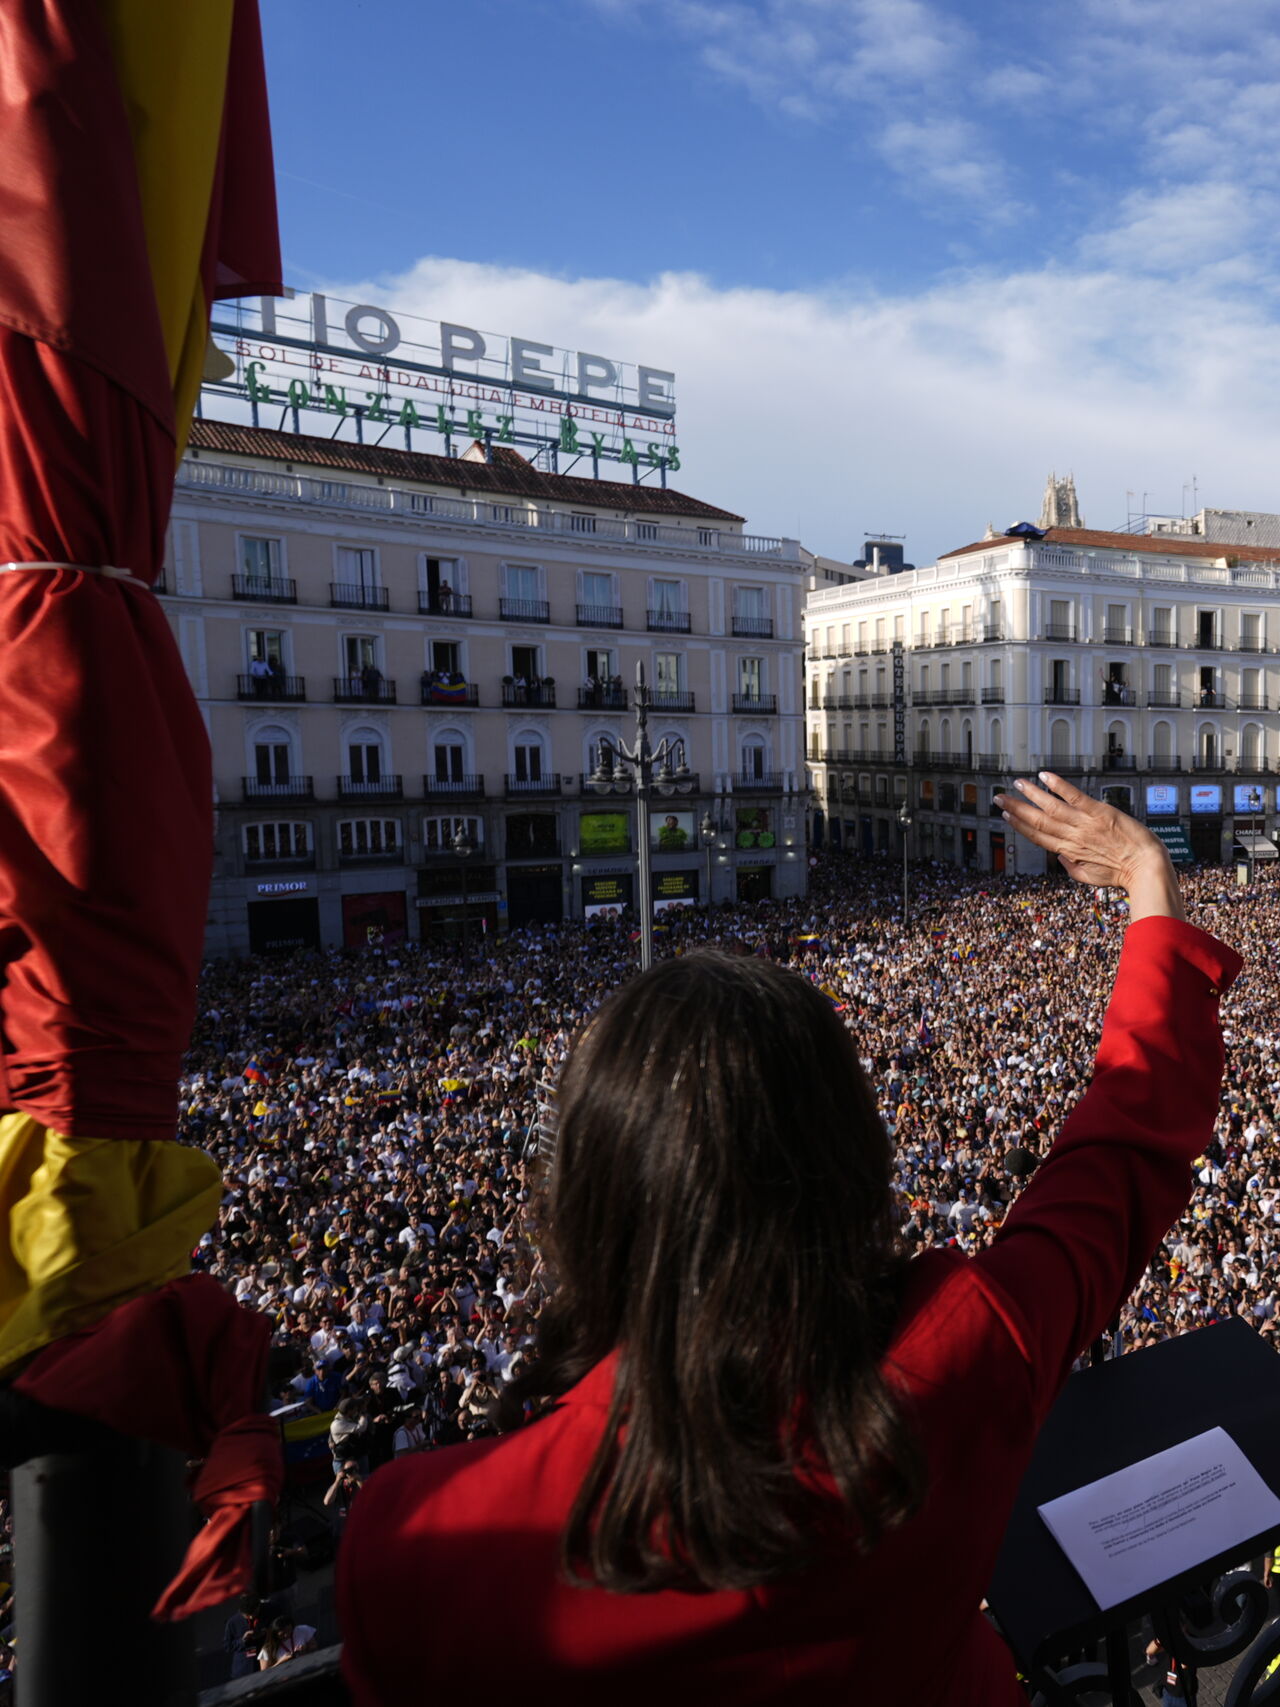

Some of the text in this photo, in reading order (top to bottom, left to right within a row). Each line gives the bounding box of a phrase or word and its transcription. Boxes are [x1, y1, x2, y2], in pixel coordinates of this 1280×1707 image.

[236, 340, 676, 436] SOL DE ANDALUCIA EMBOTELLADO
[439, 321, 676, 414] PEPE
[244, 361, 681, 471] GONZALEZ BYASS
[894, 648, 905, 762] HOTEL EUROPA
[1235, 828, 1262, 836] CHANGE
[256, 881, 308, 894] PRIMOR
